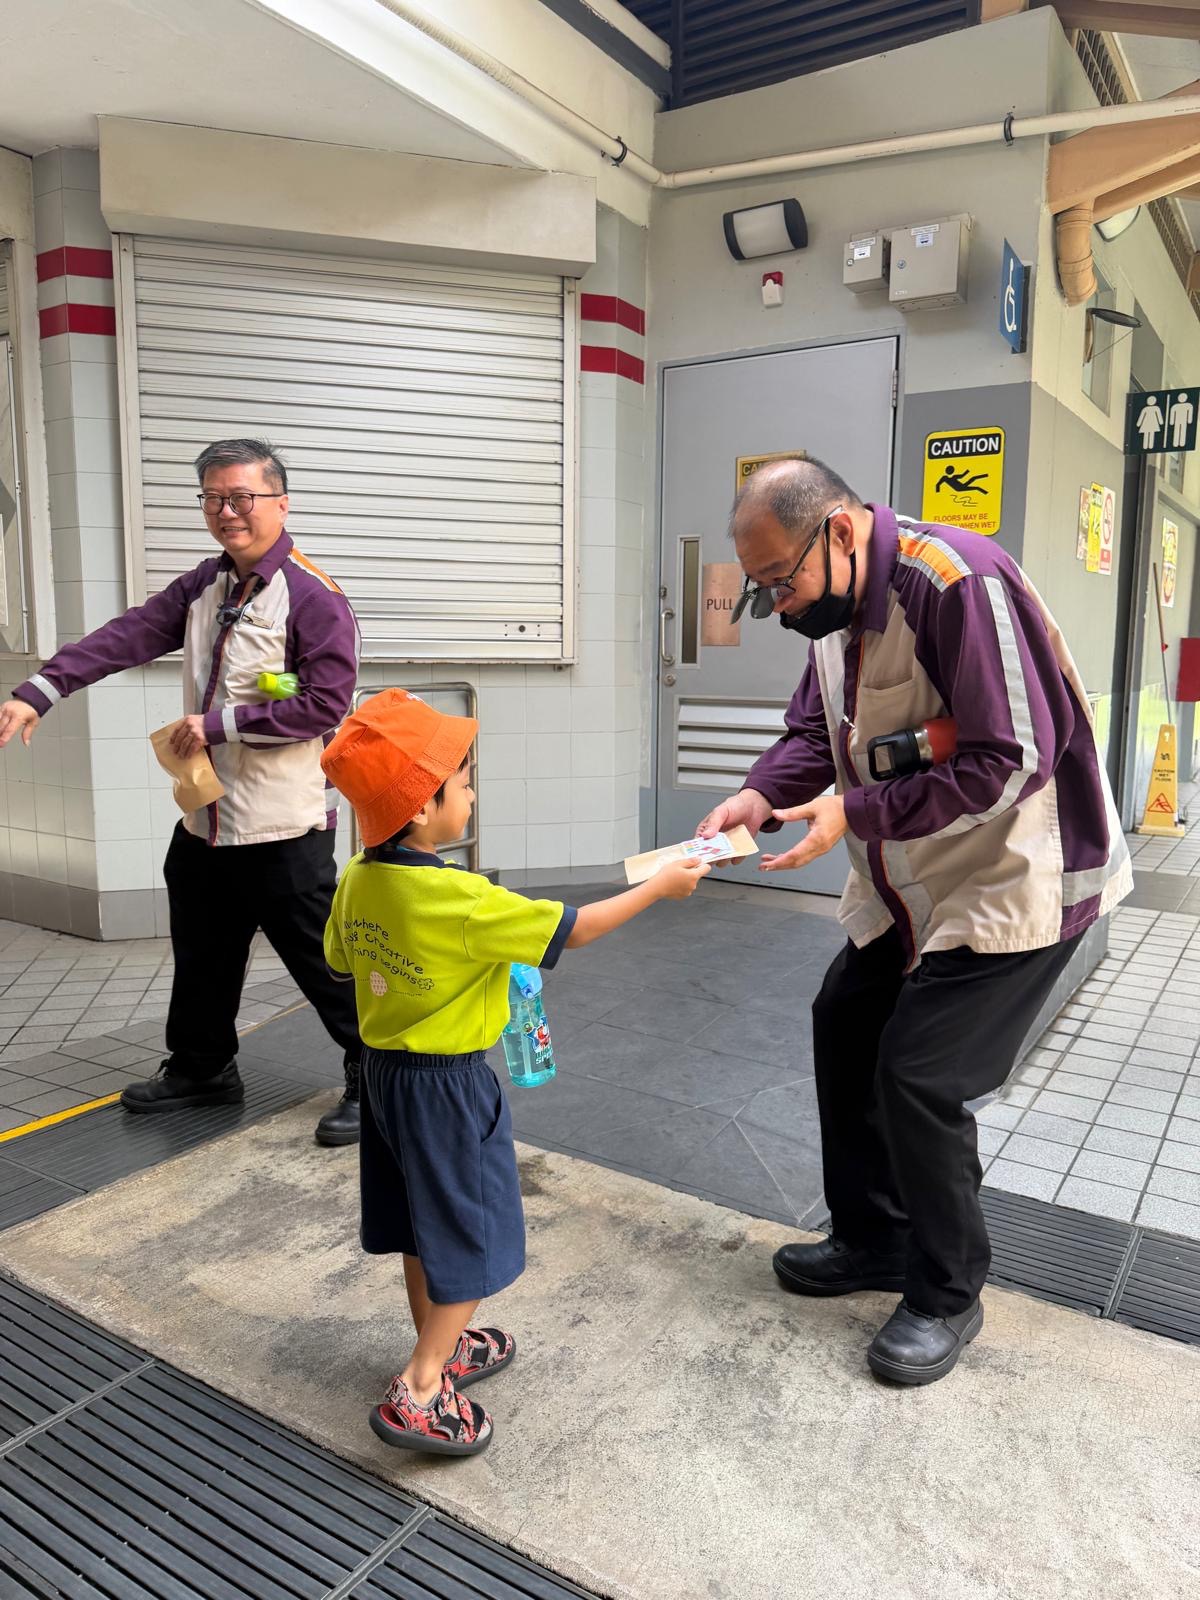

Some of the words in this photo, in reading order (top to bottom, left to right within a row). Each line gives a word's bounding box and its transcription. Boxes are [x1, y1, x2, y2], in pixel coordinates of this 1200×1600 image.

[931, 437, 999, 456] CAUTION
[934, 514, 961, 522] FLOORS
[963, 513, 979, 521] MAY
[979, 512, 988, 520] BE
[960, 521, 980, 529] WHEN
[706, 598, 733, 611] PULL
